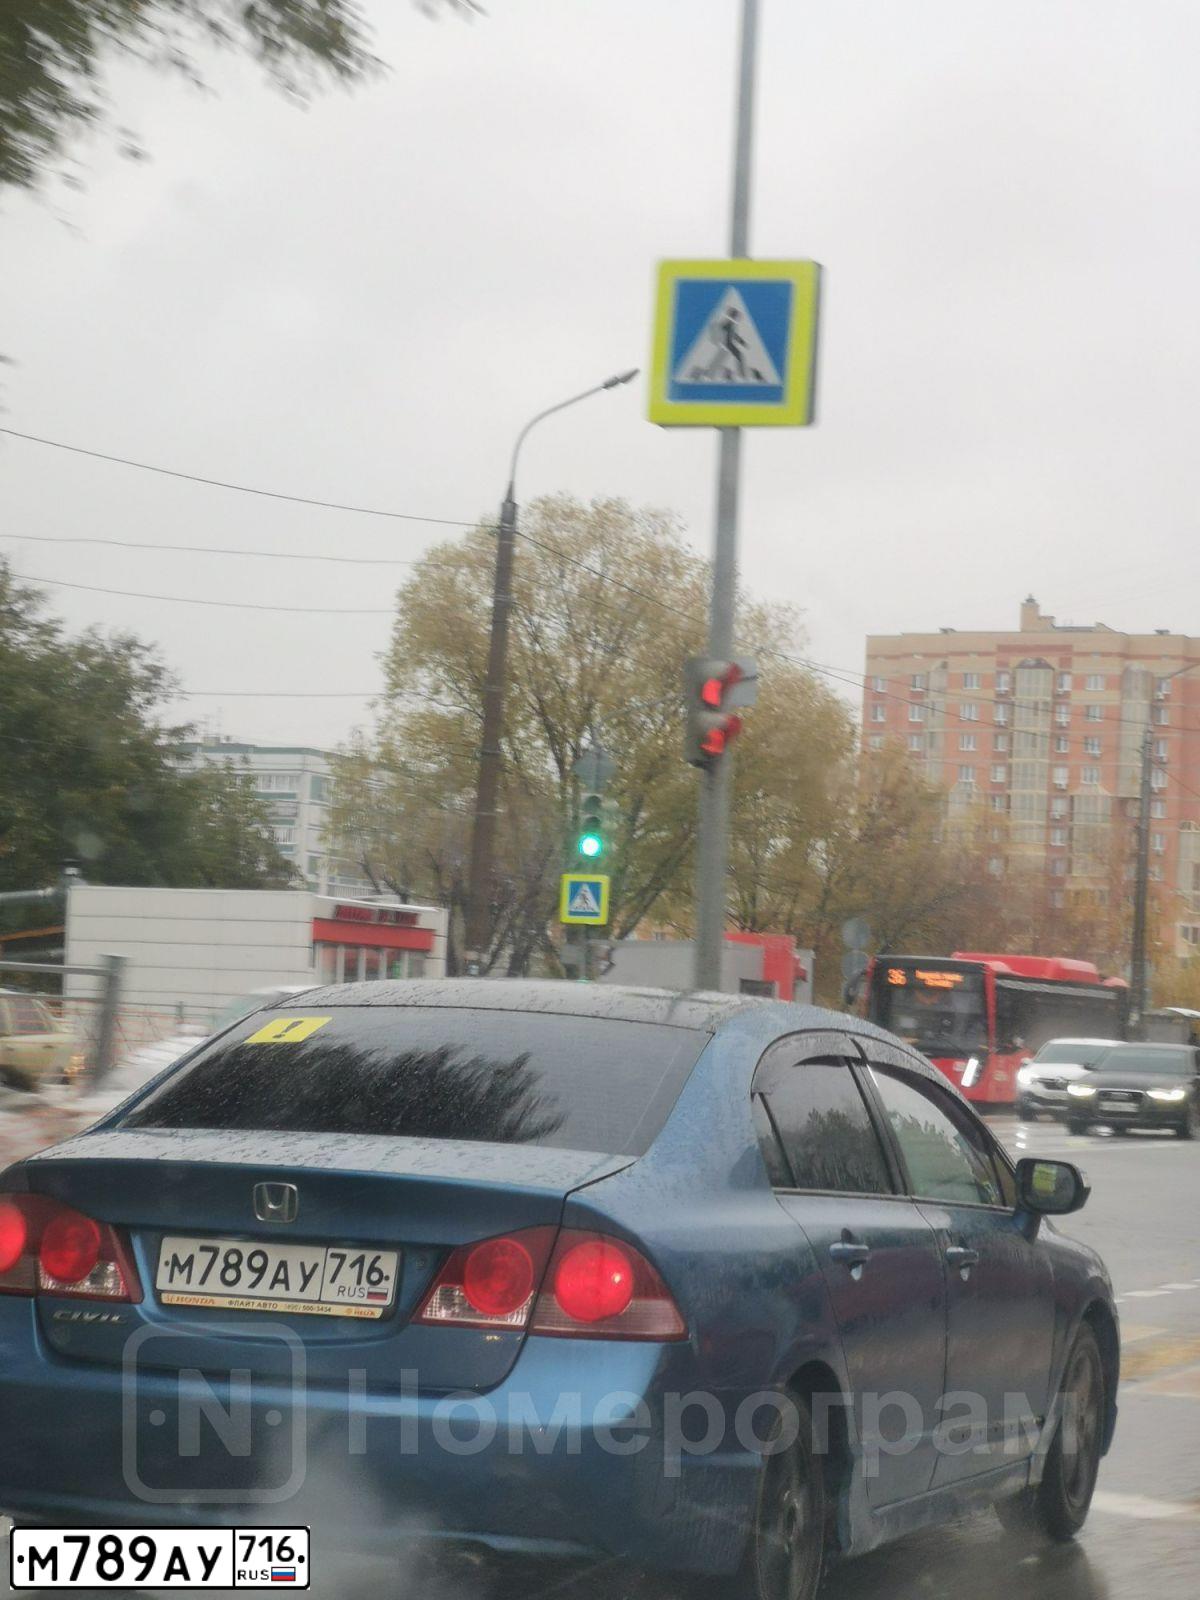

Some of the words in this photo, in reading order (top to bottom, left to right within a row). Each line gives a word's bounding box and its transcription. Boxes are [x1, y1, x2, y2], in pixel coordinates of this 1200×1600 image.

[168, 1245, 319, 1293] М789АУ
[329, 1252, 384, 1286] 716
[337, 1285, 366, 1298] RUS
